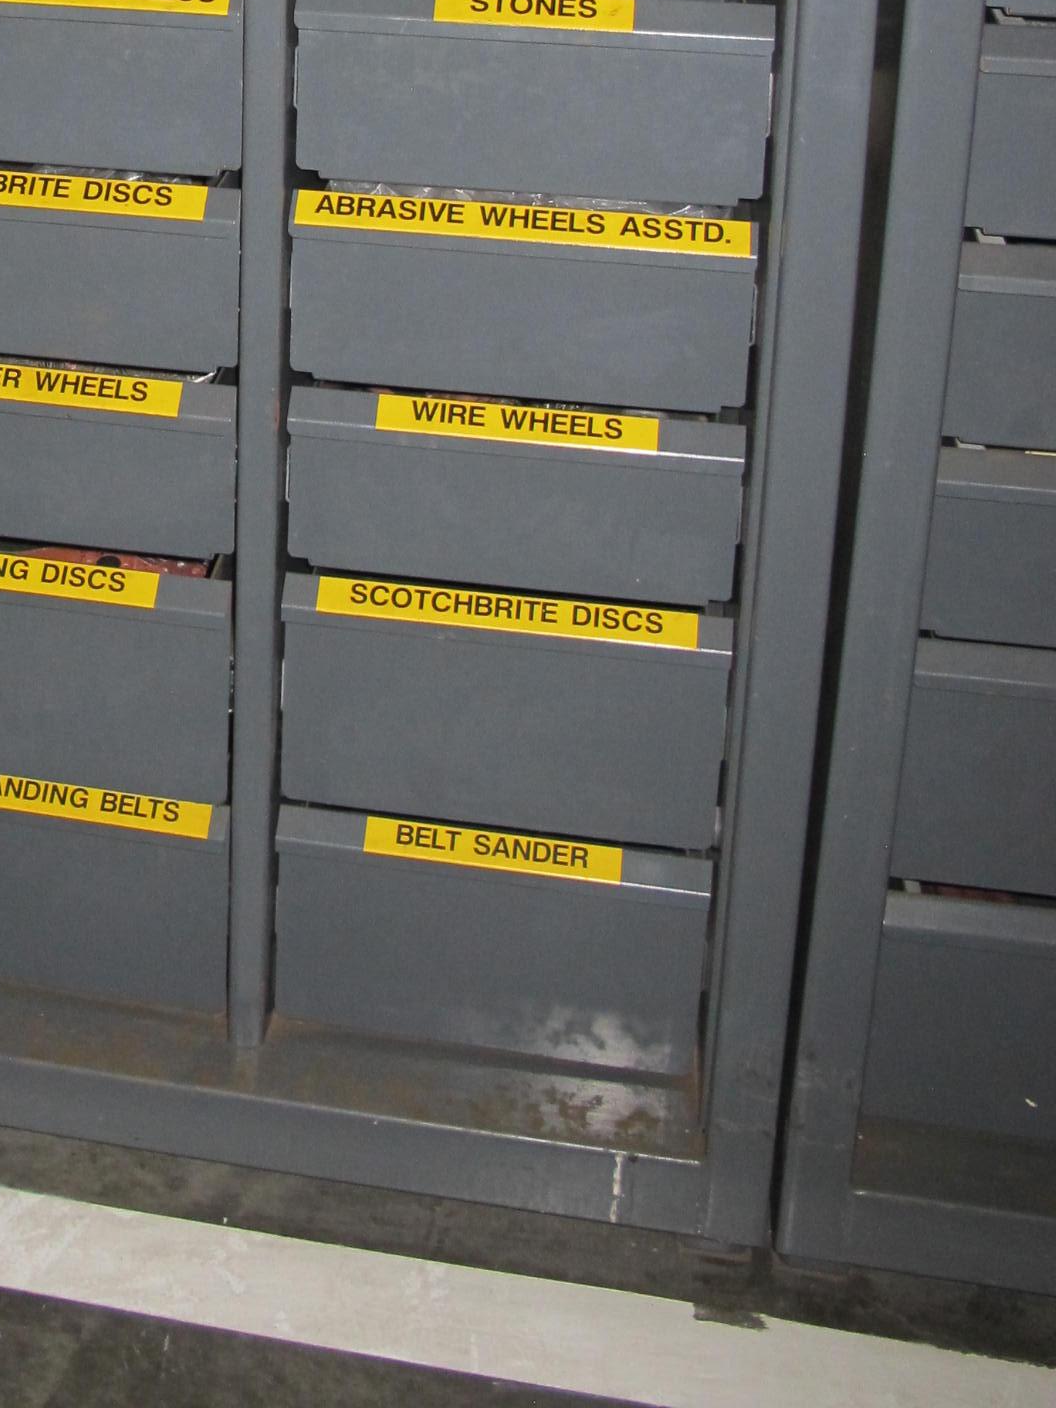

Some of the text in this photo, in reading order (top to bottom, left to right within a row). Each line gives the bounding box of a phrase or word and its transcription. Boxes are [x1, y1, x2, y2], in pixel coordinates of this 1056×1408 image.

[83, 180, 173, 206] DISCS
[315, 195, 731, 244] ABRASIVE WHEELS ASSTD.
[36, 371, 148, 402] WHEELS
[413, 400, 623, 440] WIRE WHEELS
[41, 563, 126, 593] DISCS
[351, 583, 663, 634] SCOTCHBRITE DISCS
[100, 792, 180, 823] BELTS
[397, 824, 589, 869] BELT SANDER
